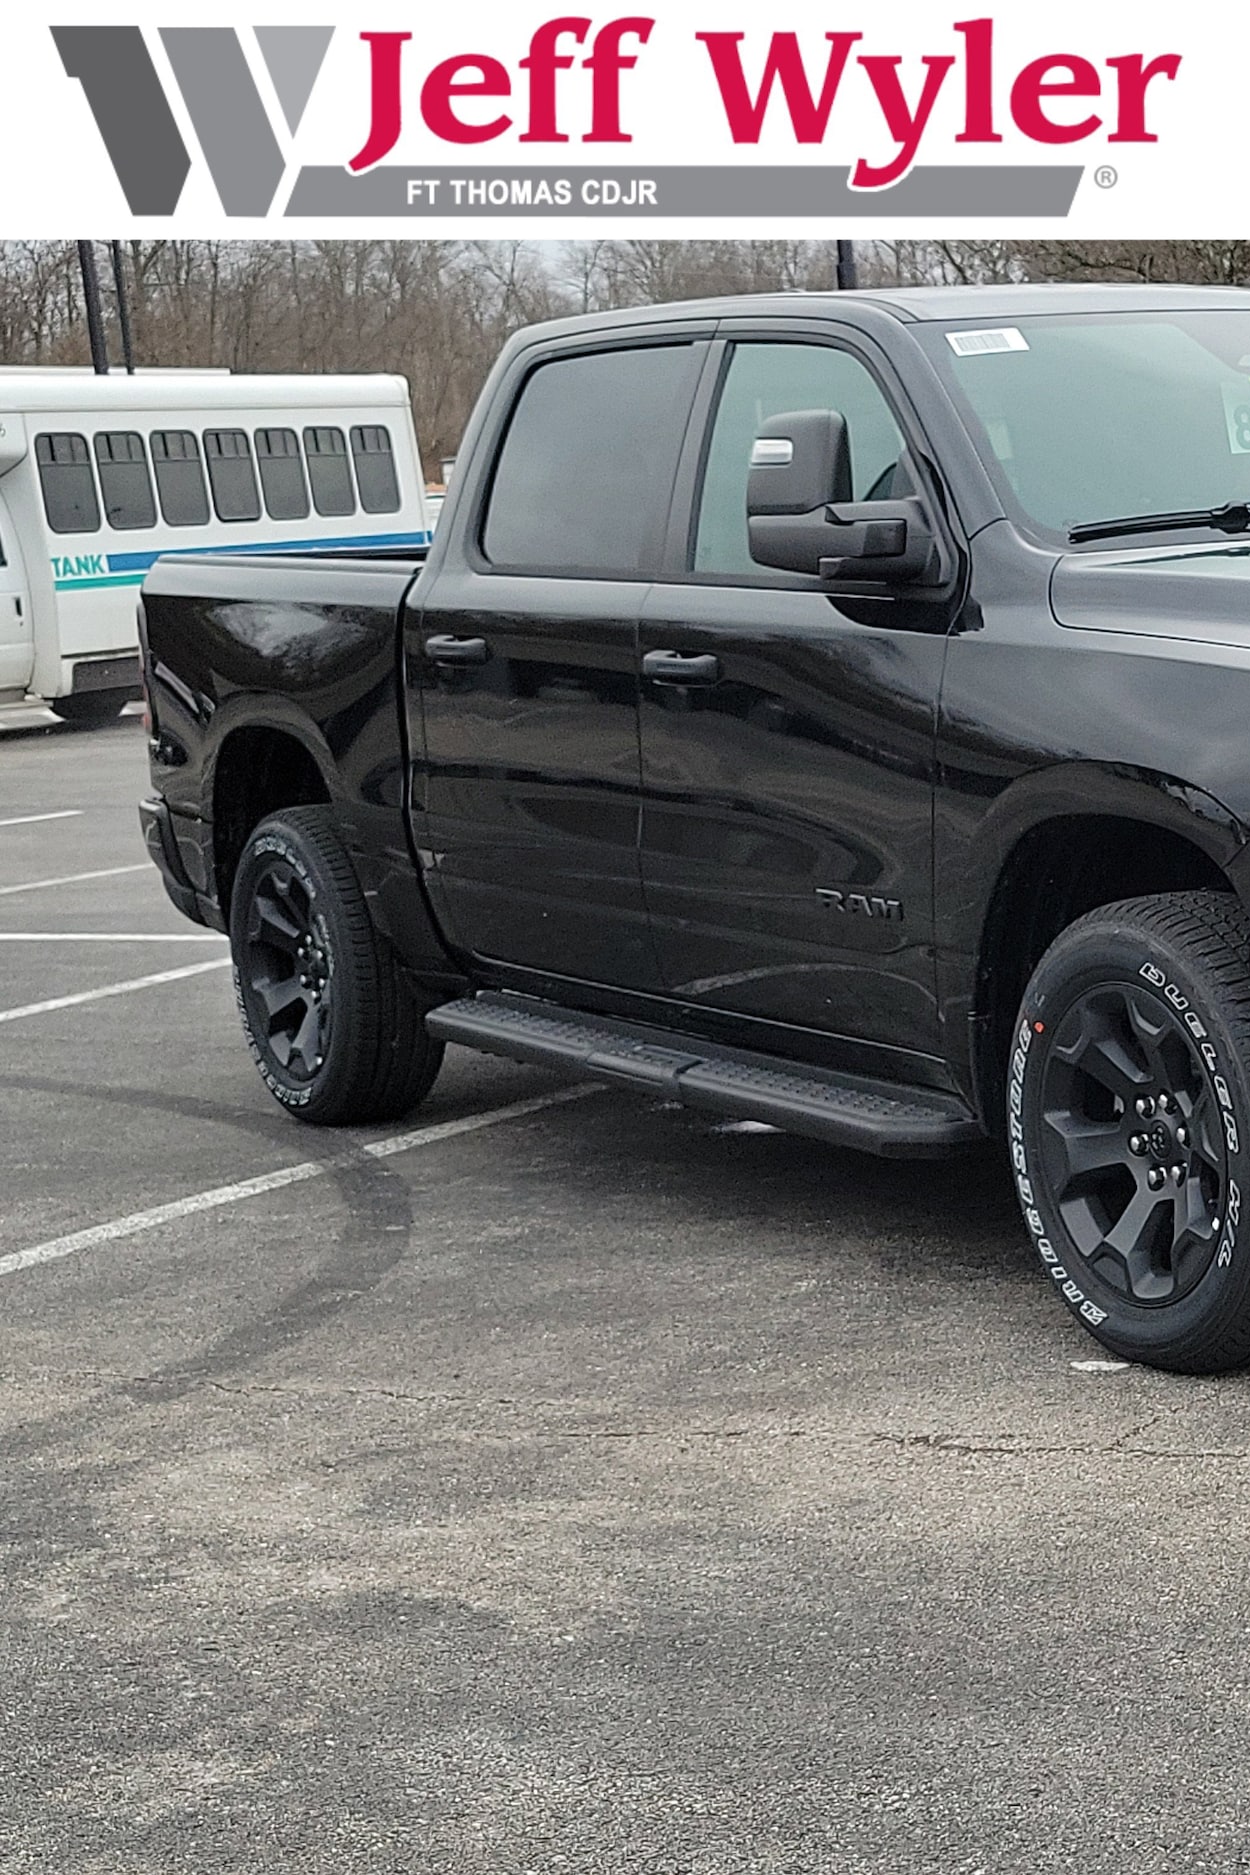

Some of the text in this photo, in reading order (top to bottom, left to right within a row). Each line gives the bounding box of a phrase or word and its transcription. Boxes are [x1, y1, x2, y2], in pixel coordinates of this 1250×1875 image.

[50, 554, 105, 577] TANK
[815, 887, 904, 921] RAM
[1139, 962, 1240, 1153] DUELER
[1009, 1018, 1108, 1327] BRIDGESTONE
